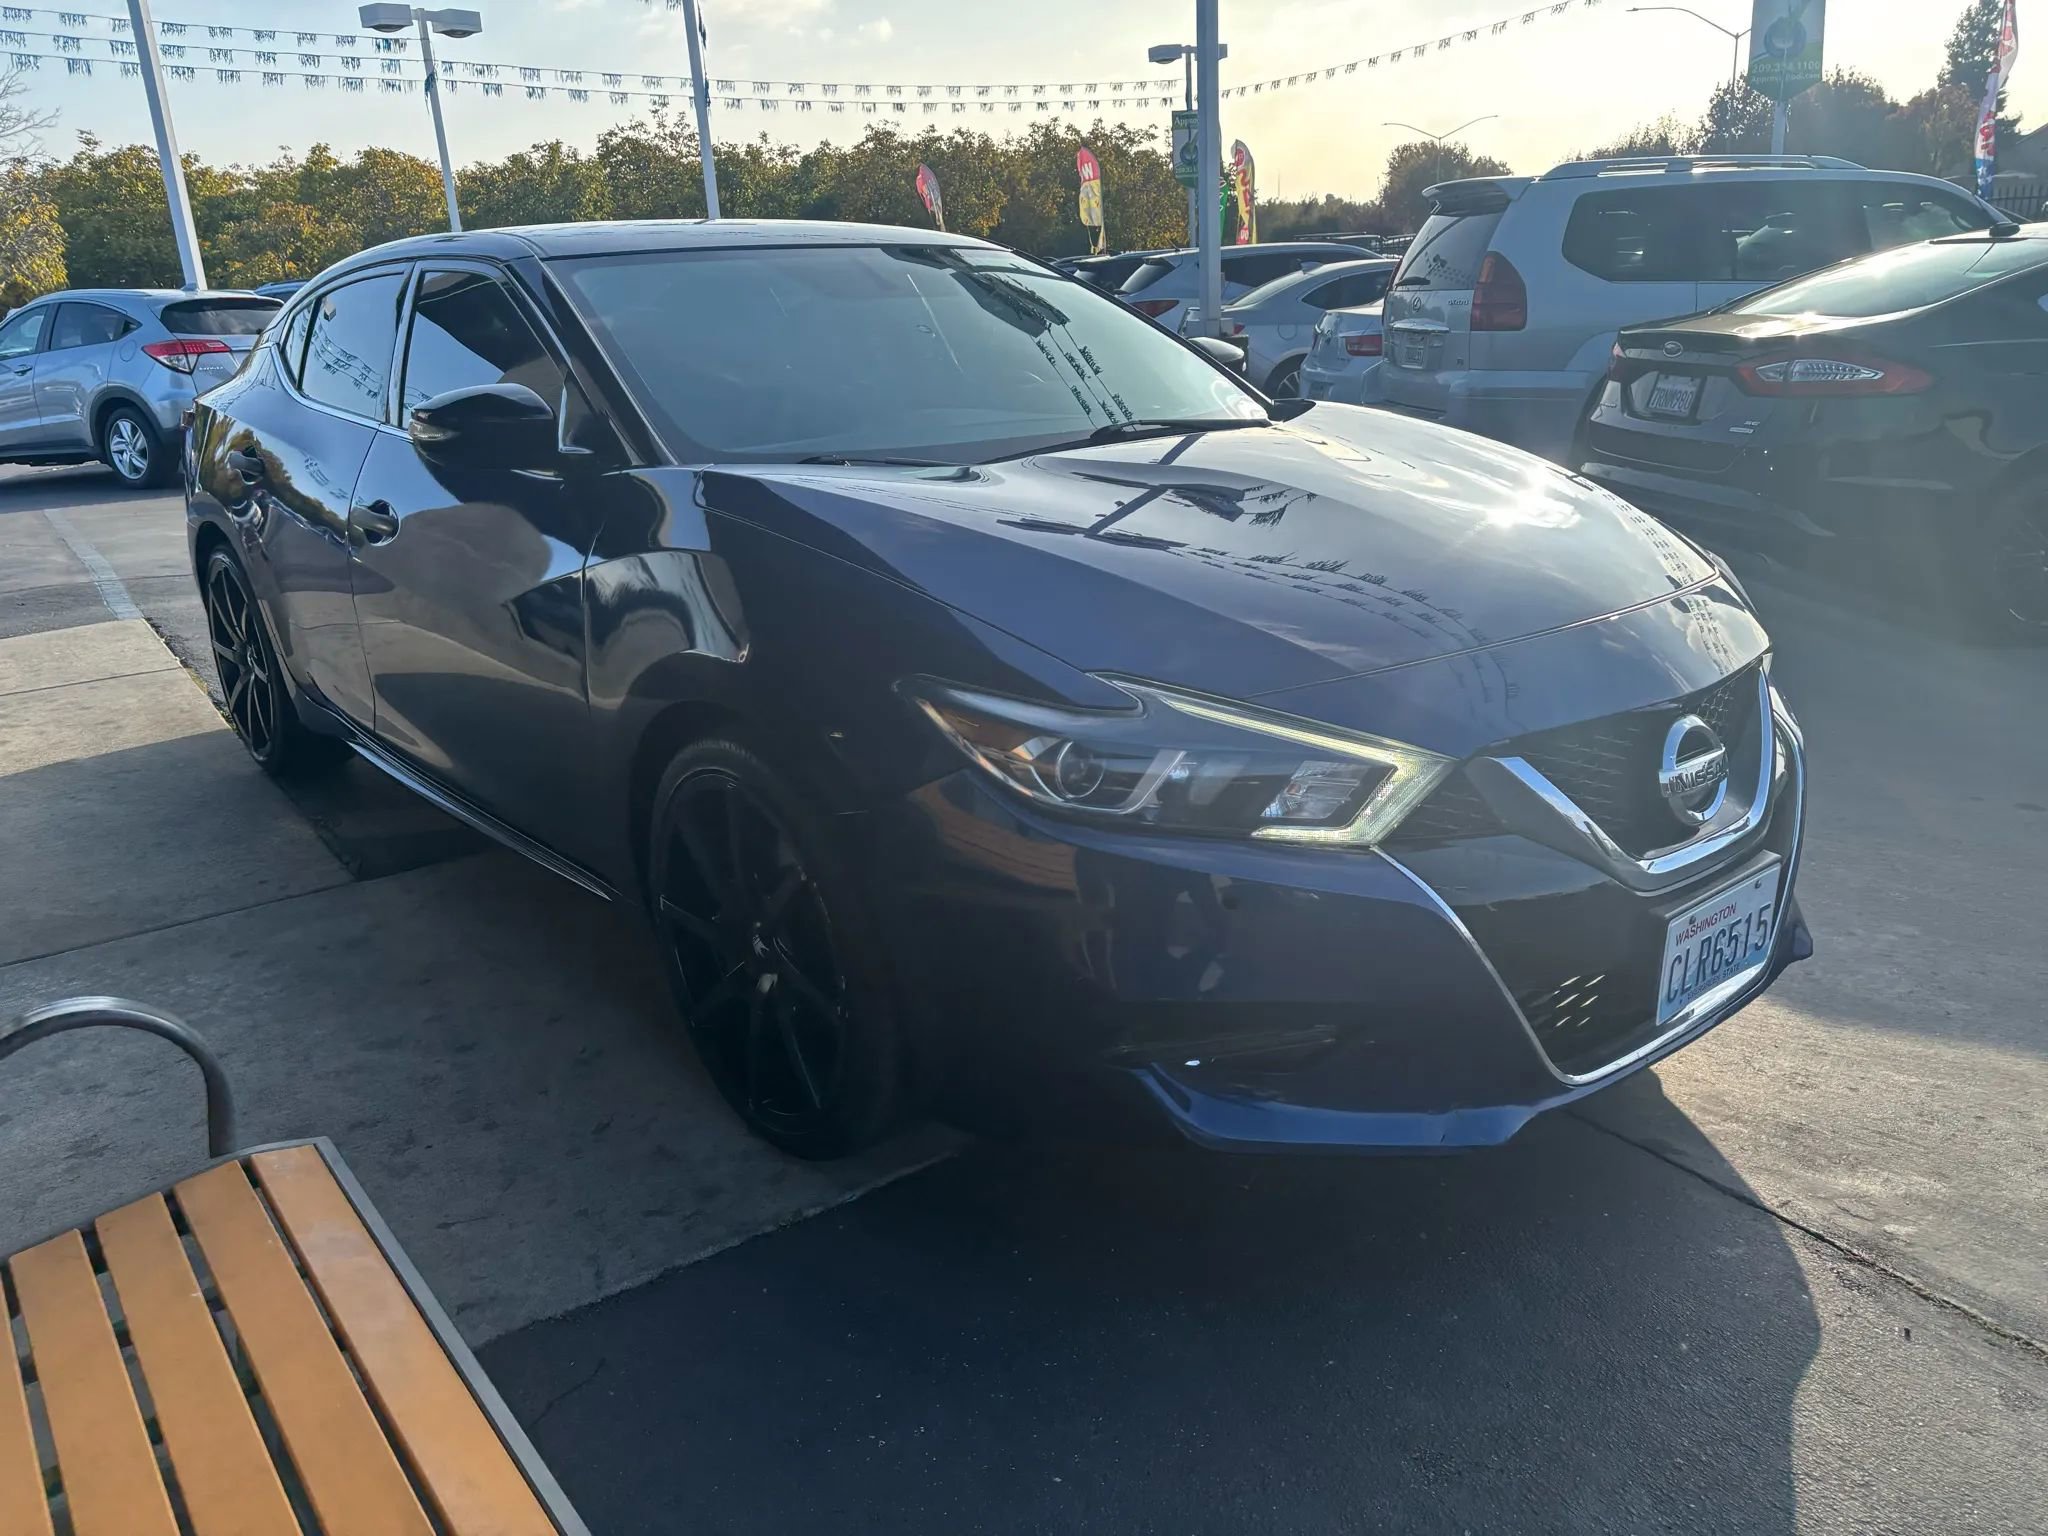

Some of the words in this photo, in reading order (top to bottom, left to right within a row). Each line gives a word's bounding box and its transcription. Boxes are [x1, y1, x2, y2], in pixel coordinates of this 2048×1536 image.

[1675, 902, 1737, 946] WASHINGTON
[1667, 902, 1771, 1004] CLR6515
[1722, 962, 1741, 980] STATE
